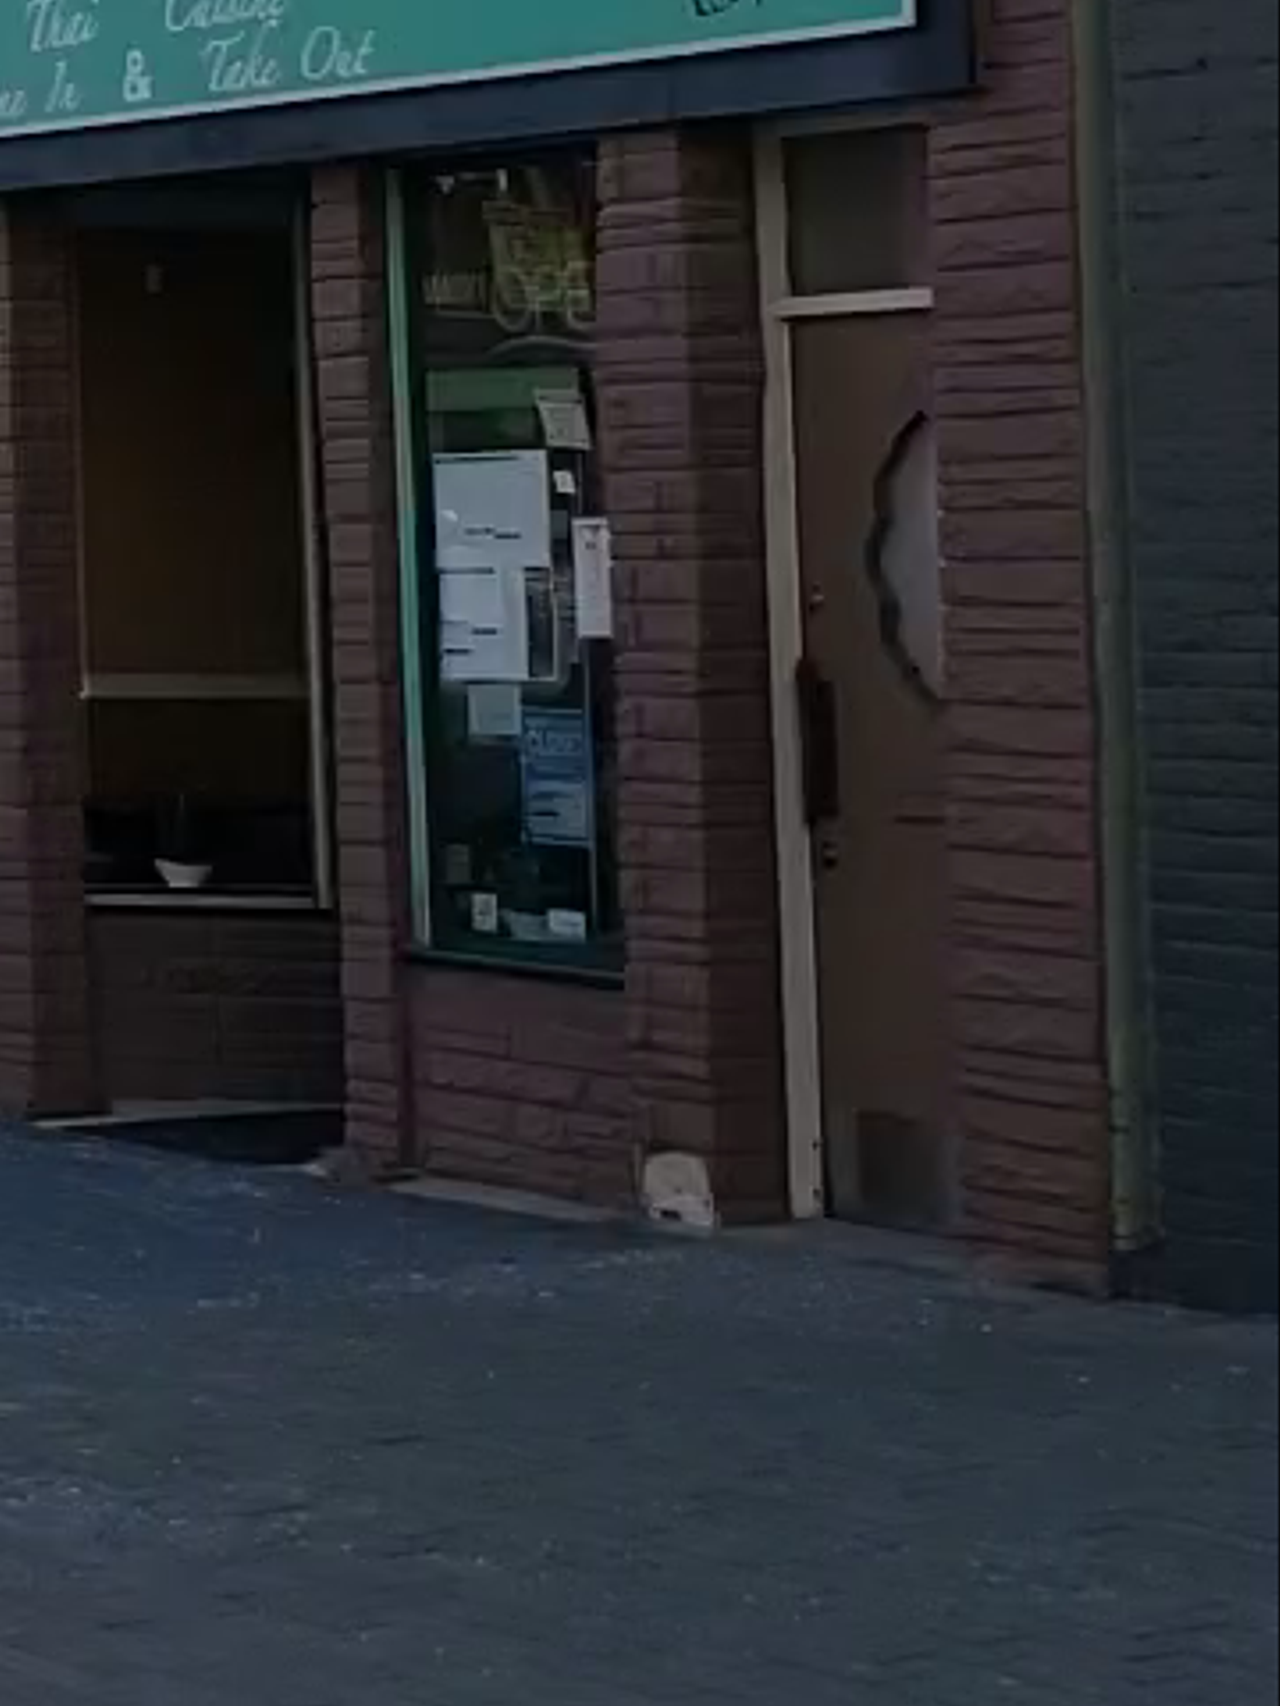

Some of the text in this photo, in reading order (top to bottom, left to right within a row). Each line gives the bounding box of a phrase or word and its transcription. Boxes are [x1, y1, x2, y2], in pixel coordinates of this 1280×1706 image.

[45, 60, 82, 114] In
[122, 49, 153, 102] &
[201, 19, 283, 93] Take
[300, 26, 377, 80] Out
